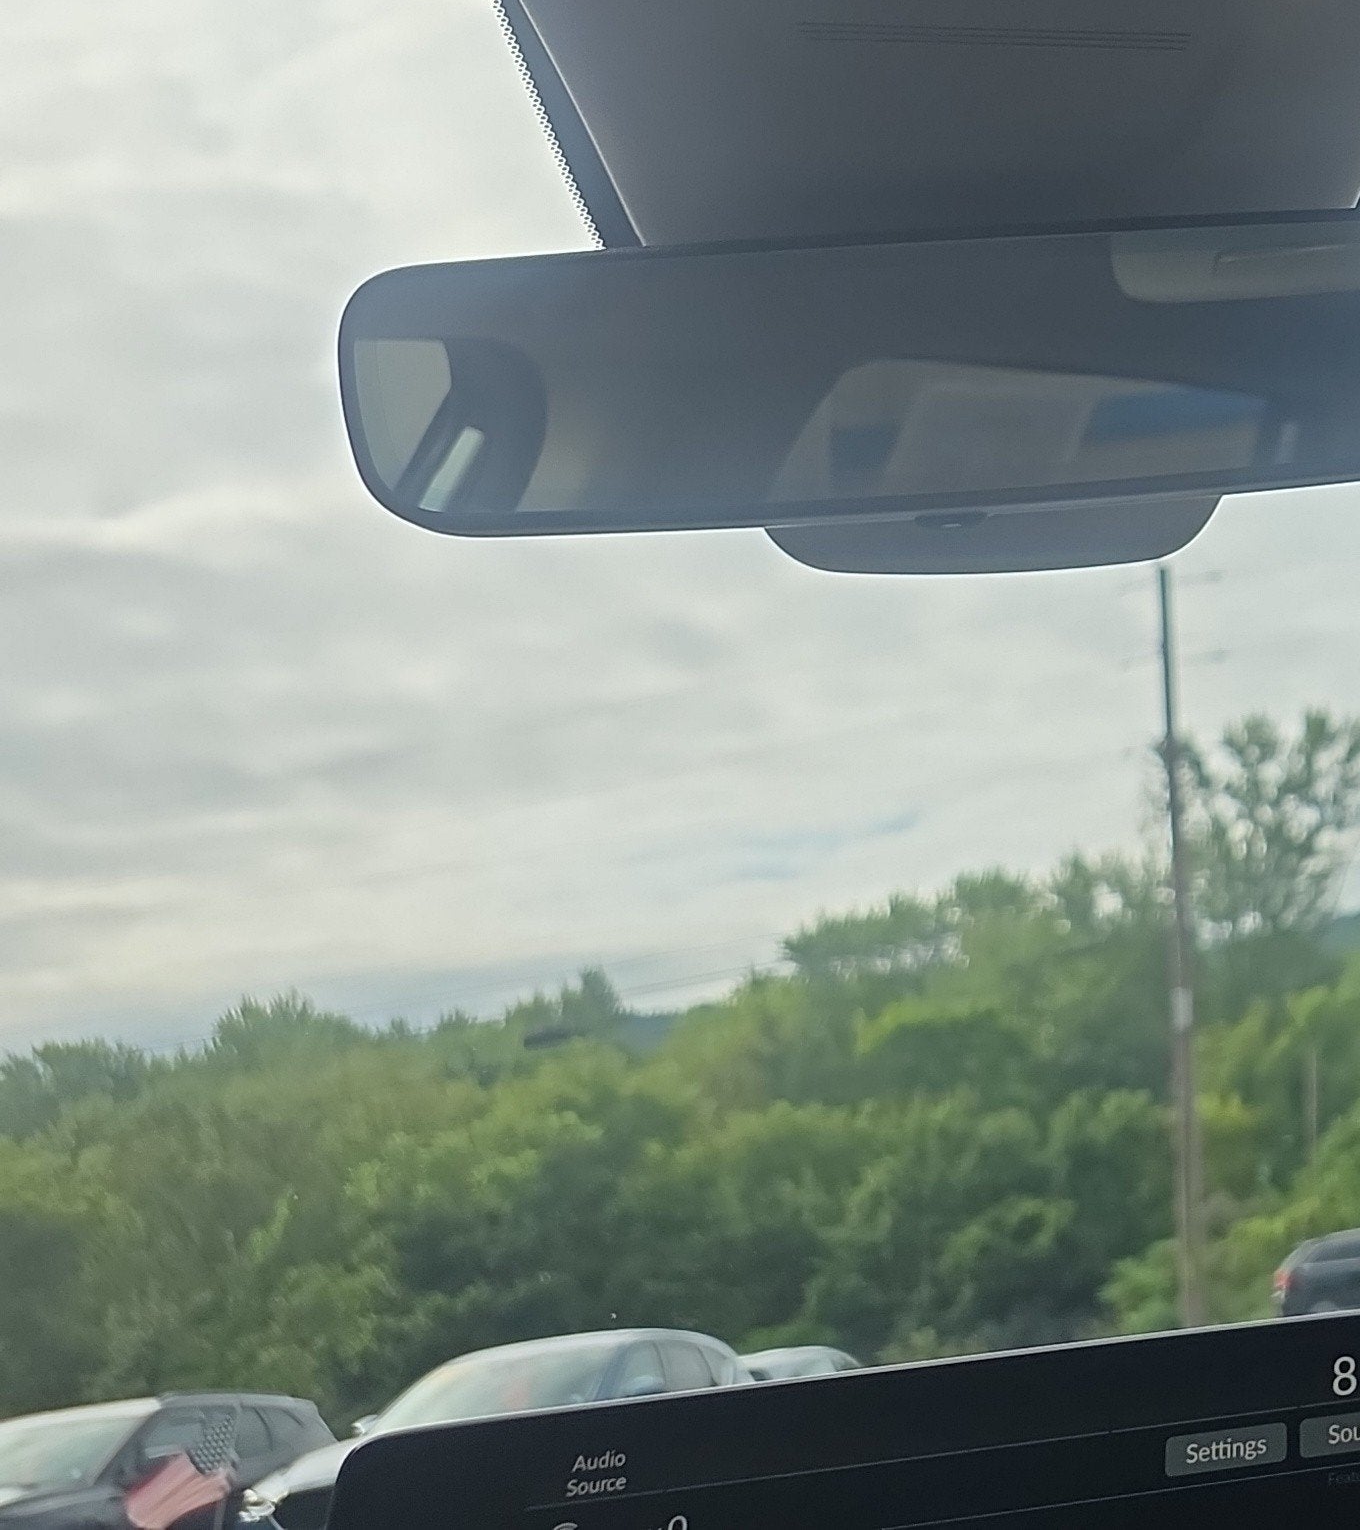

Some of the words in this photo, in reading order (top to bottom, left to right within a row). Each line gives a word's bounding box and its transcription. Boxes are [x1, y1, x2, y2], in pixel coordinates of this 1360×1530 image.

[571, 1449, 626, 1474] Audio
[1185, 1436, 1268, 1465] Settings
[565, 1476, 628, 1498] Source
